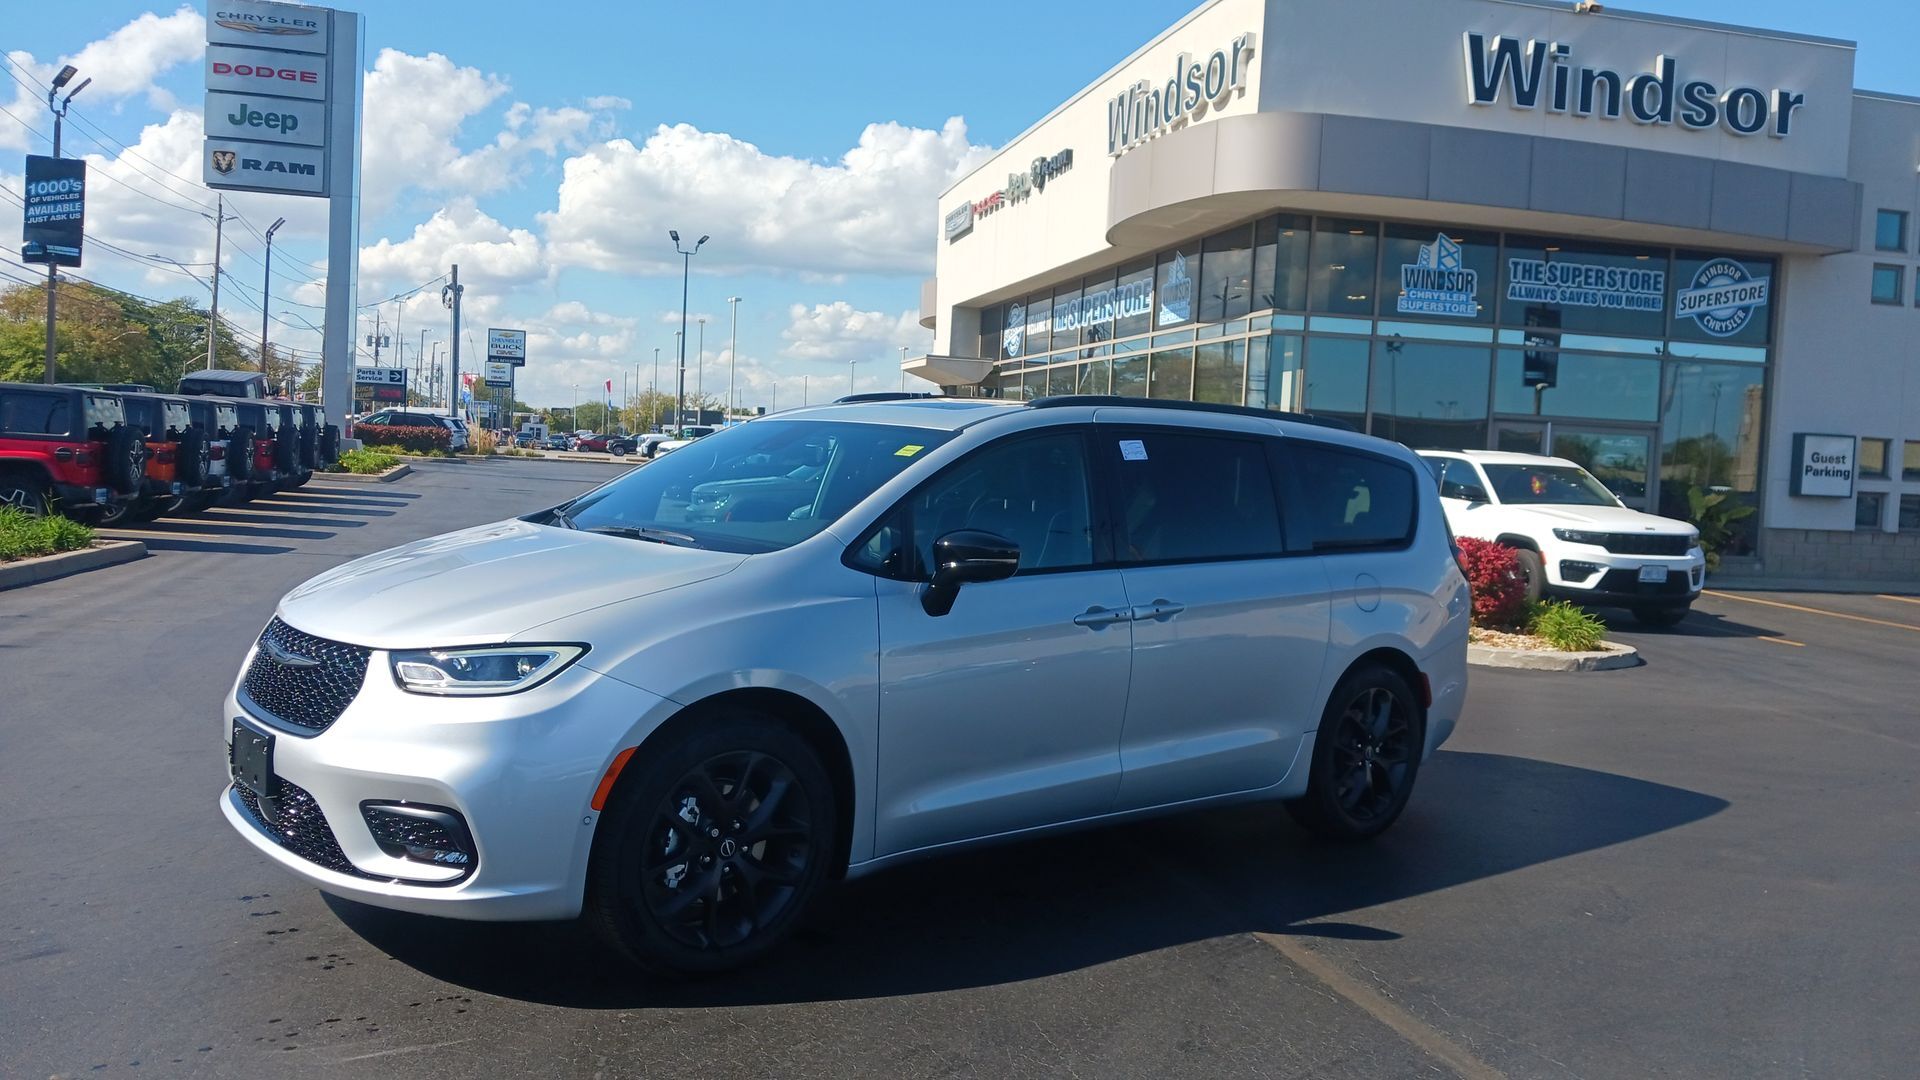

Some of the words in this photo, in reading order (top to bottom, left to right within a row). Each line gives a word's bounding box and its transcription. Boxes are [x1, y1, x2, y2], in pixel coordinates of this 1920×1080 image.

[216, 11, 317, 28] CHRYSLER
[213, 62, 318, 84] DODGE
[1107, 32, 1256, 158] Windsor
[1463, 31, 1805, 138] Windsor
[228, 103, 299, 134] Jeep
[241, 158, 316, 176] RAM
[42, 193, 80, 202] VEHICLES
[28, 202, 82, 217] AVAILABLE
[1404, 268, 1474, 293] WINDSOR
[1510, 261, 1544, 283] THE
[1546, 262, 1664, 293] SUPERSTORE
[1699, 264, 1742, 285] WINDSOR
[1068, 278, 1153, 330] SUPERSTORE
[1401, 300, 1475, 313] SUPERSTORE
[1409, 290, 1466, 302] CHRYSLER
[1509, 285, 1557, 301] ALWAYS
[1559, 289, 1599, 306] SAVES
[1601, 294, 1623, 308] YOU
[1625, 296, 1661, 310] MORE!
[1680, 285, 1765, 311] SUPERSTORE
[1703, 309, 1746, 332] CHRYSLER
[1811, 452, 1847, 465] Guest
[1804, 465, 1851, 480] Parking
